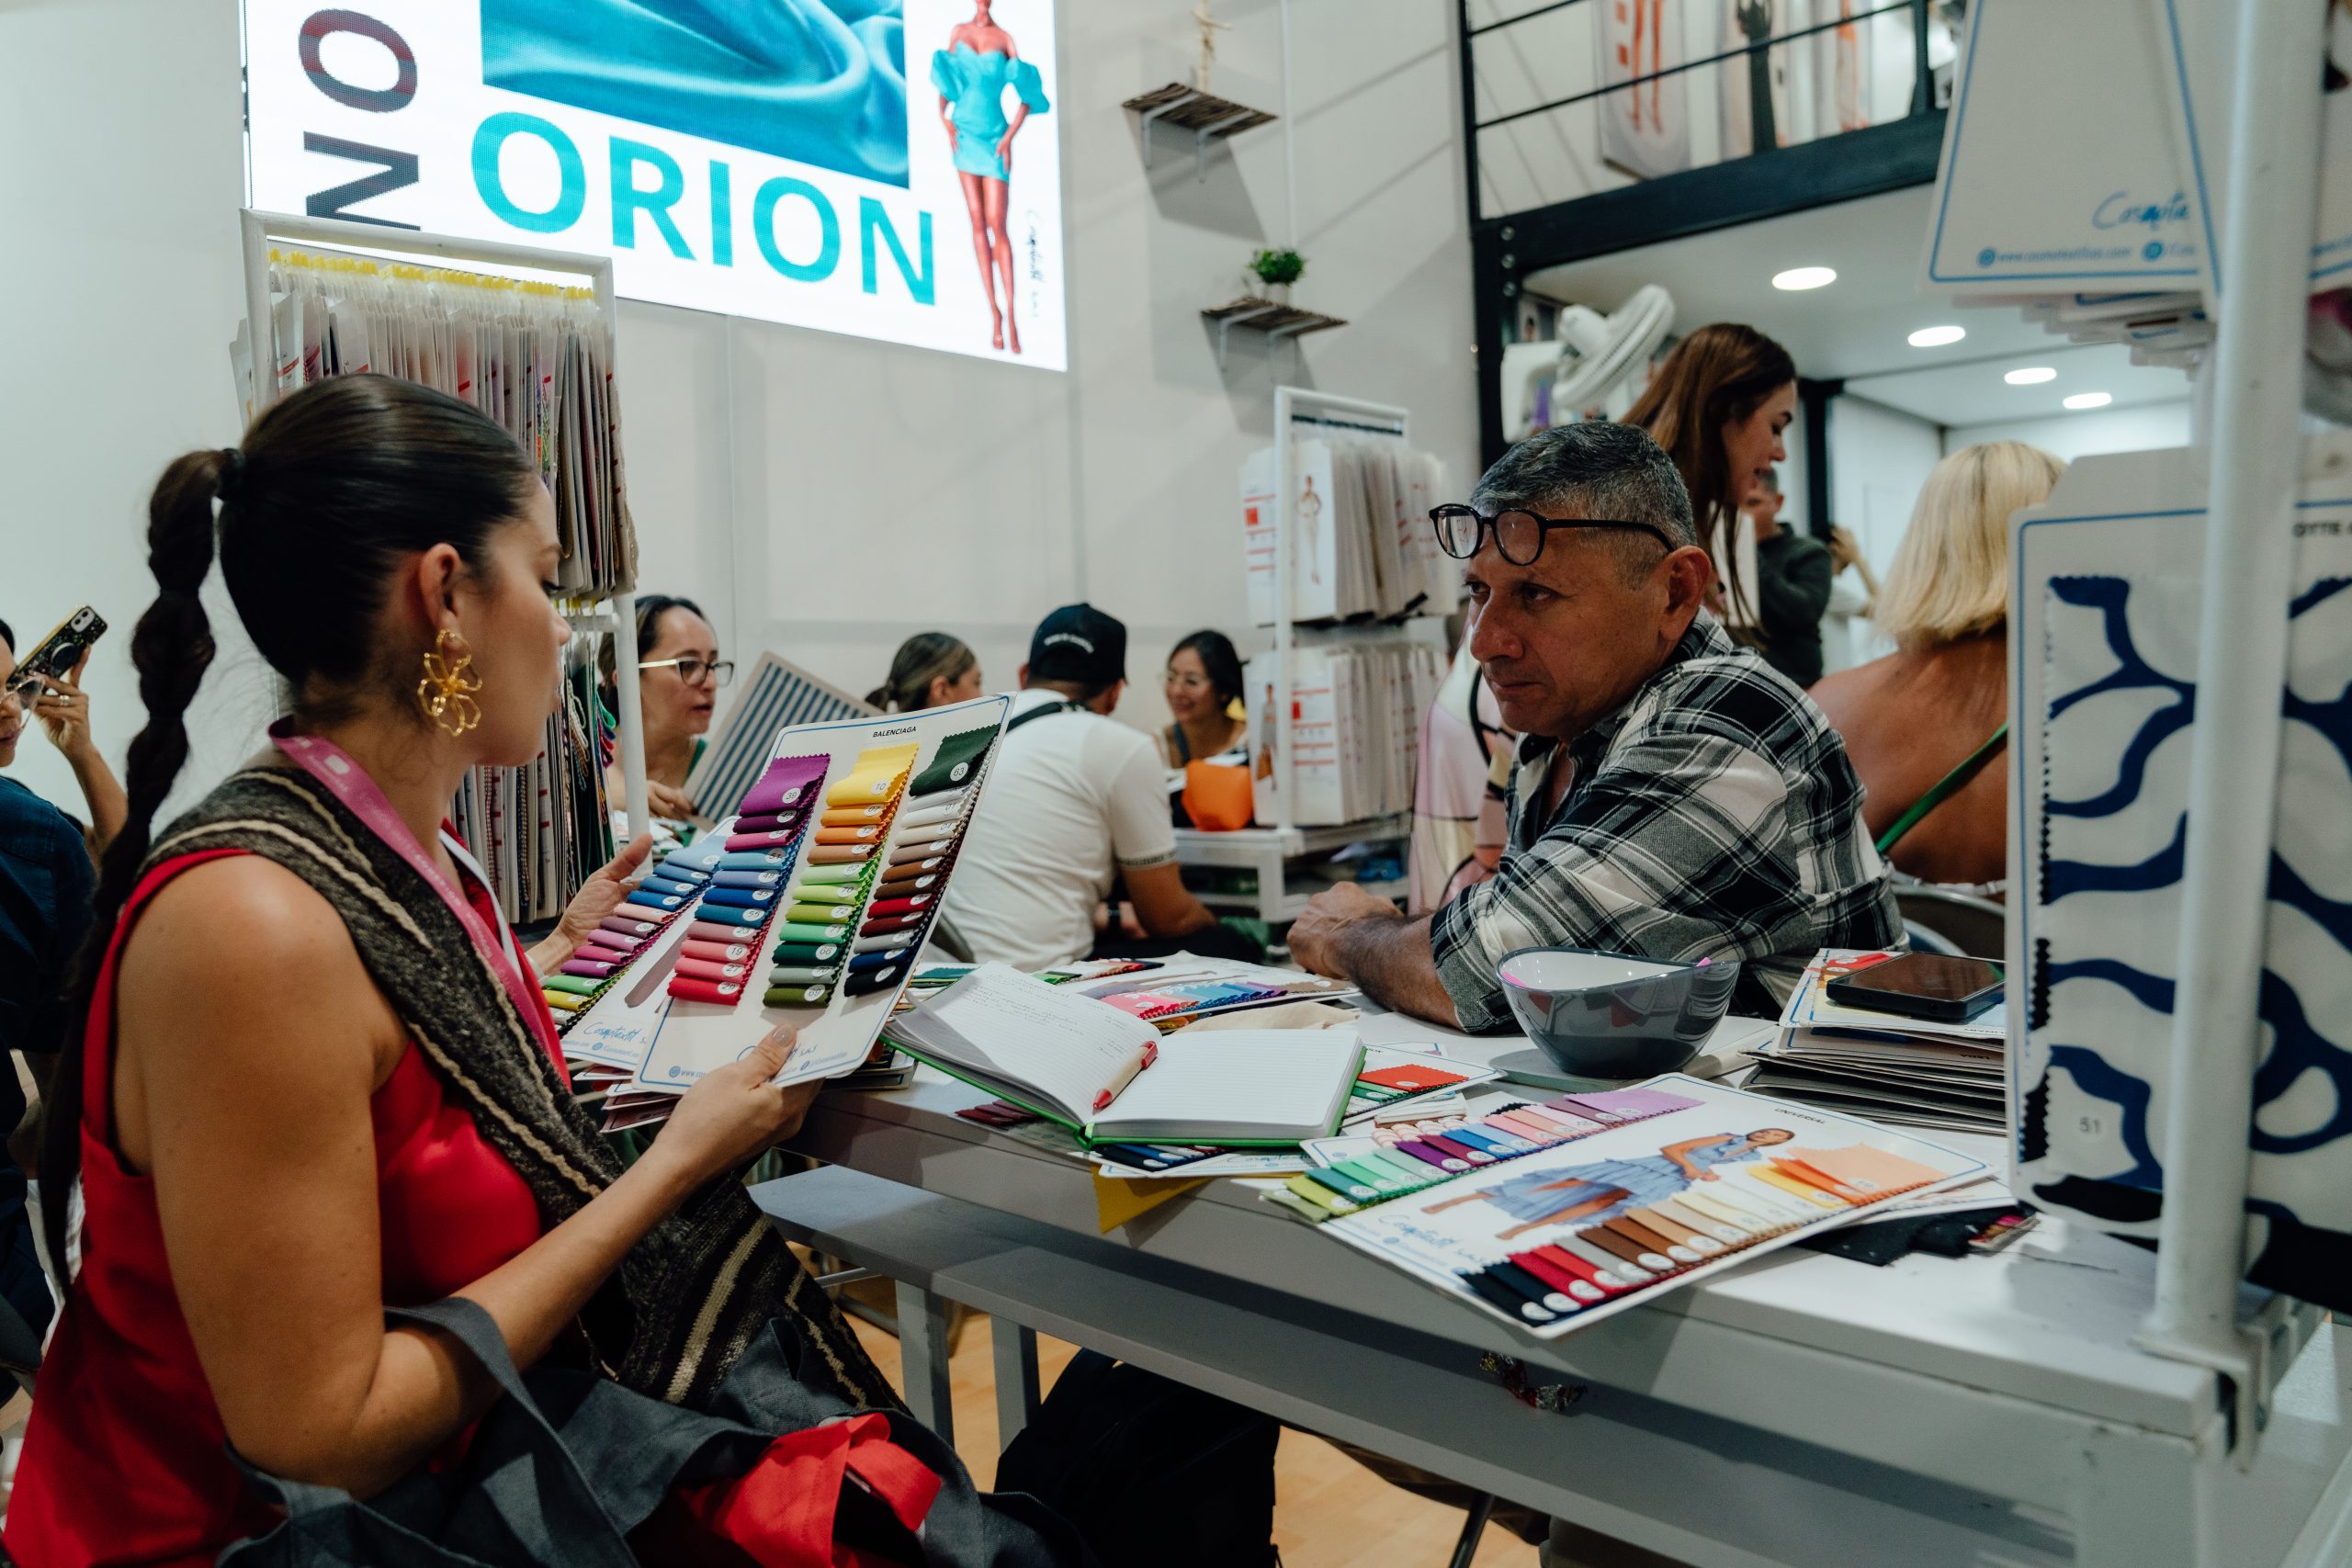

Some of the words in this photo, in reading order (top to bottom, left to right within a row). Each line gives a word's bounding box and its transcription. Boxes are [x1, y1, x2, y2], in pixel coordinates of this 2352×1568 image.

[471, 111, 935, 306] ORION
[873, 726, 917, 738] BALENCIAGA
[2079, 1116, 2101, 1134] 51
